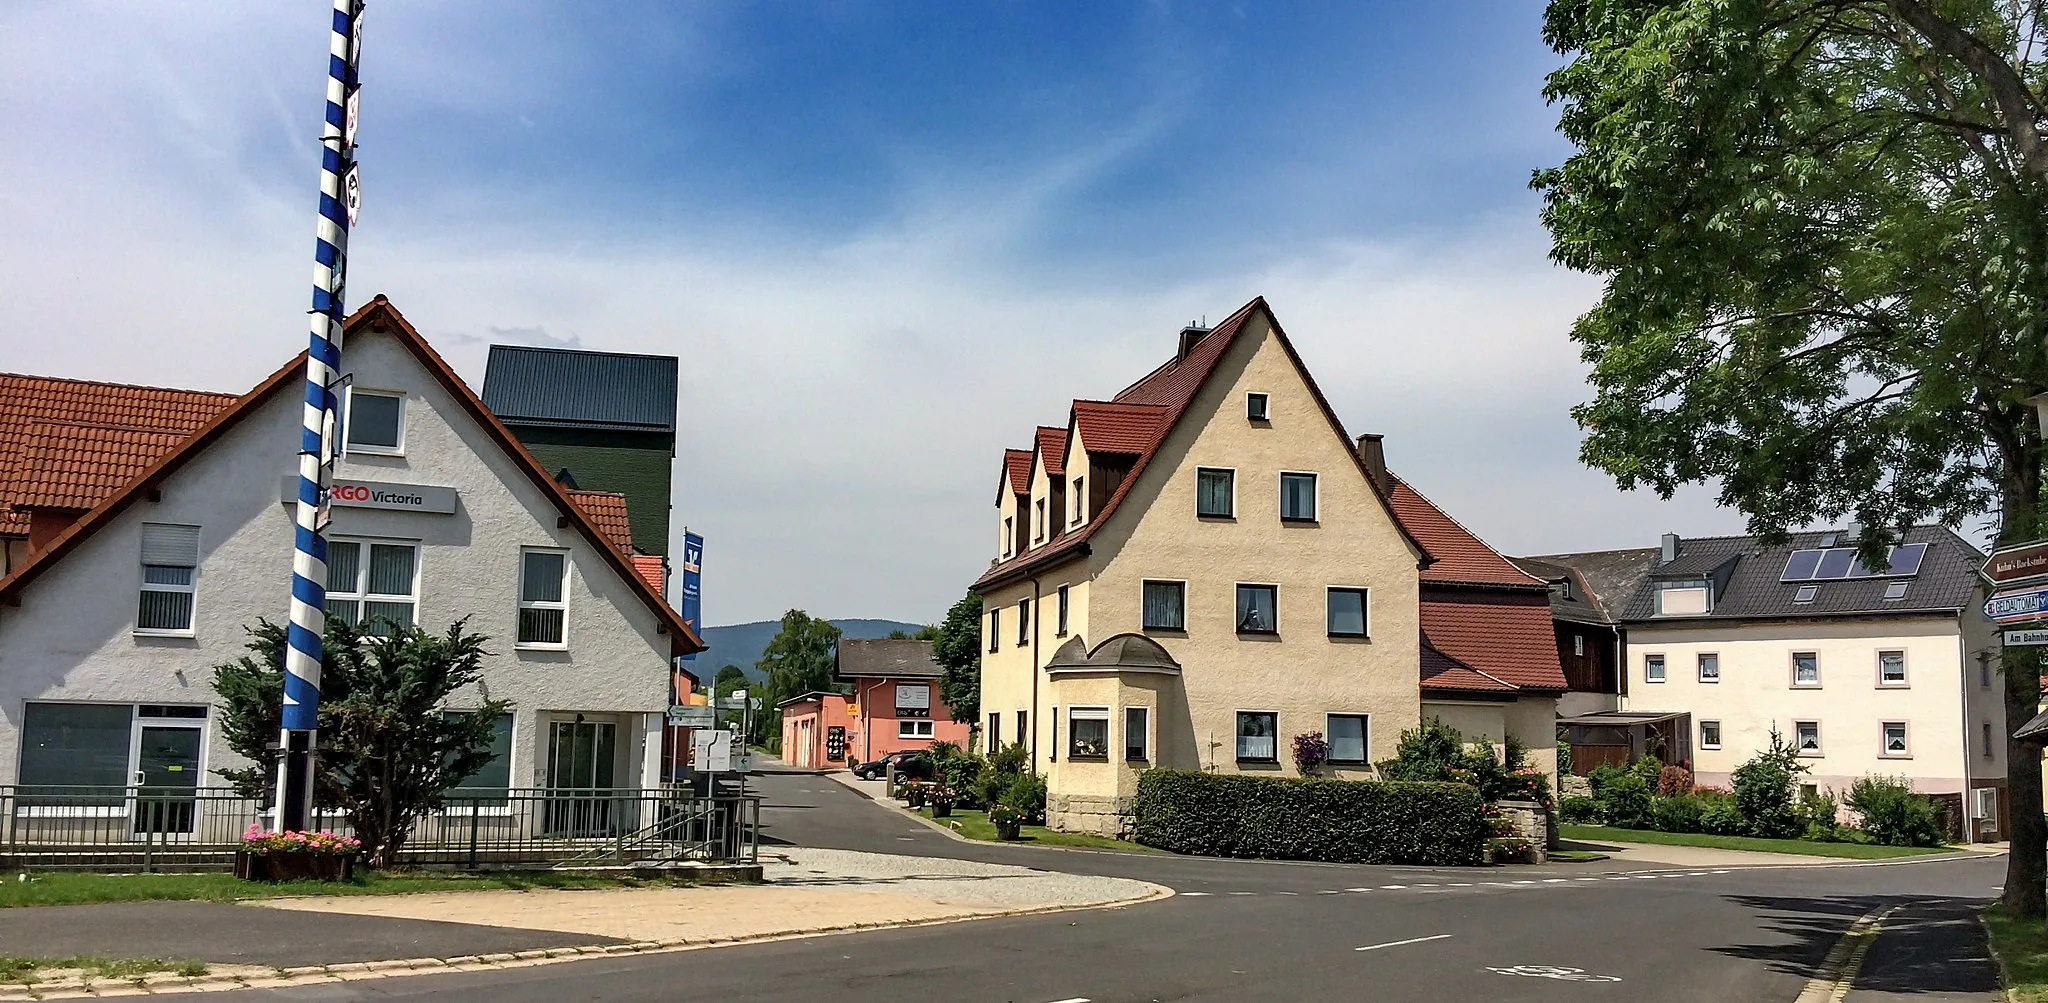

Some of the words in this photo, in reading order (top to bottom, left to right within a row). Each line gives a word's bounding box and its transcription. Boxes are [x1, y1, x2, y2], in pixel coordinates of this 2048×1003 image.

[331, 484, 370, 502] RGO
[371, 490, 423, 505] Victoria
[2016, 555, 2047, 569] Backstube
[1995, 595, 2039, 613] GELDAUTOMAT
[2010, 633, 2021, 643] Am
[2023, 632, 2048, 642] Bahnho
